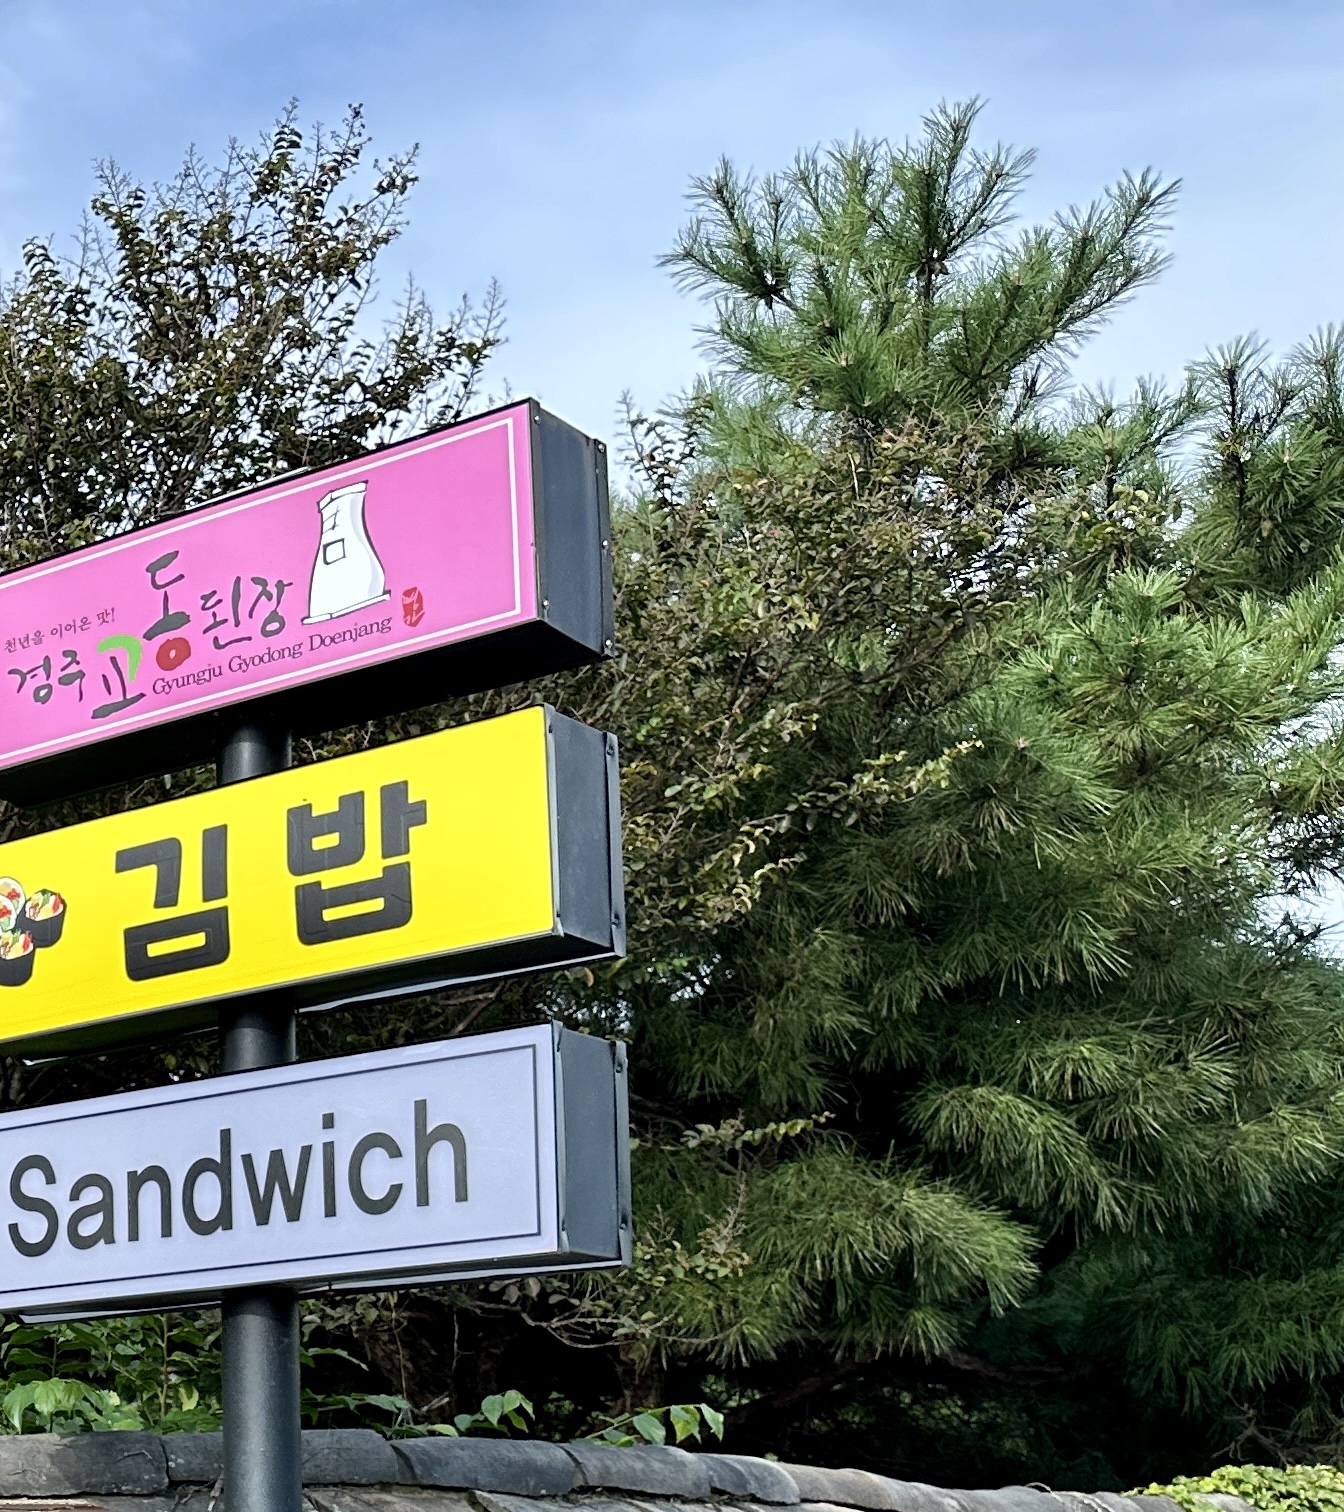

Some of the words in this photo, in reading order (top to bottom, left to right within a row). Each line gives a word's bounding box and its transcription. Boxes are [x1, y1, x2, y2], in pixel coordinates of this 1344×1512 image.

[4, 630, 44, 653] 천년을
[50, 616, 91, 639] 이어온
[152, 663, 223, 695] Gyungju
[228, 642, 303, 674] Gyodong
[309, 617, 392, 652] Doenjang
[114, 779, 427, 981] 김밥
[7, 1098, 469, 1257] Sandwich
